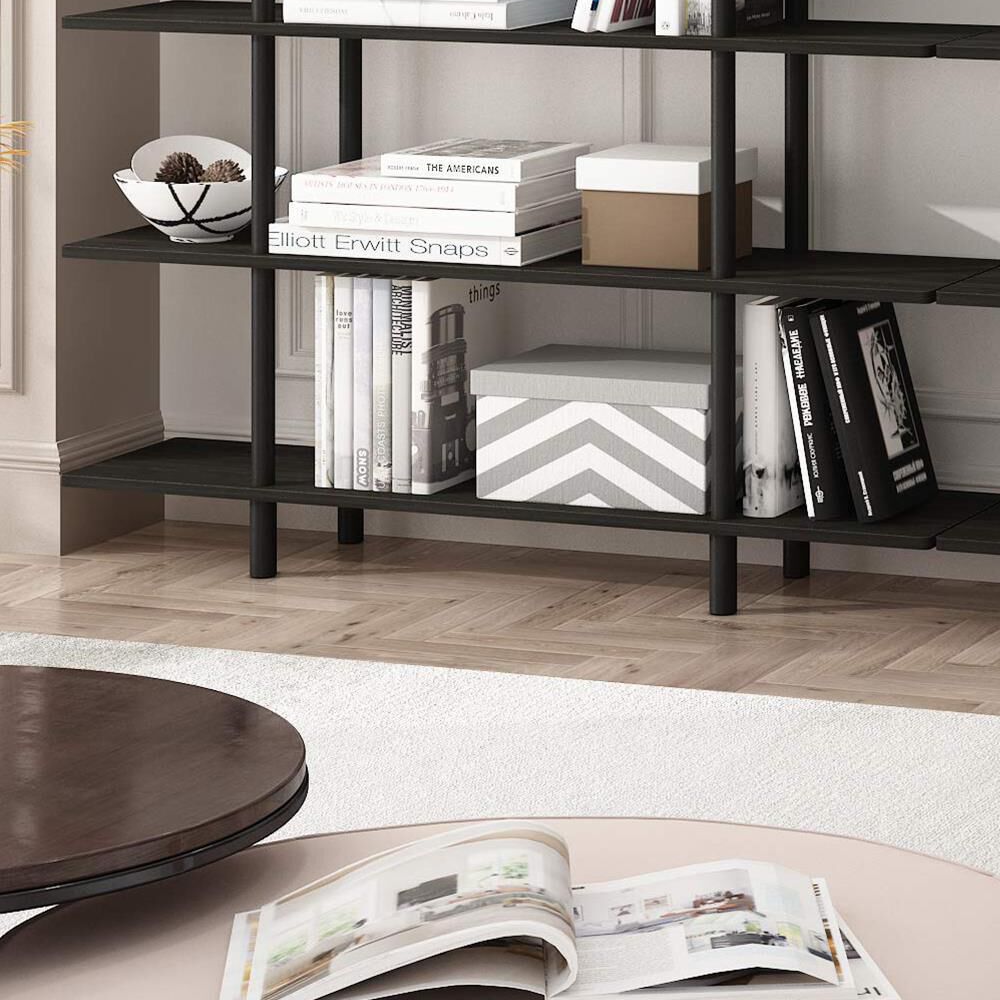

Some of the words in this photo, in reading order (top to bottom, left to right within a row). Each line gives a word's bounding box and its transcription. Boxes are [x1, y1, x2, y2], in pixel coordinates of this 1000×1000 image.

[426, 163, 444, 173] THE
[446, 164, 500, 175] AMERICANS
[269, 232, 326, 248] Elliott
[336, 234, 400, 253] Erwitt
[410, 238, 489, 259] Snaps
[469, 282, 500, 303] things
[392, 285, 402, 356] ARCHITECTURE
[400, 286, 412, 356] MINIMALIST
[356, 449, 368, 487] SNOW
